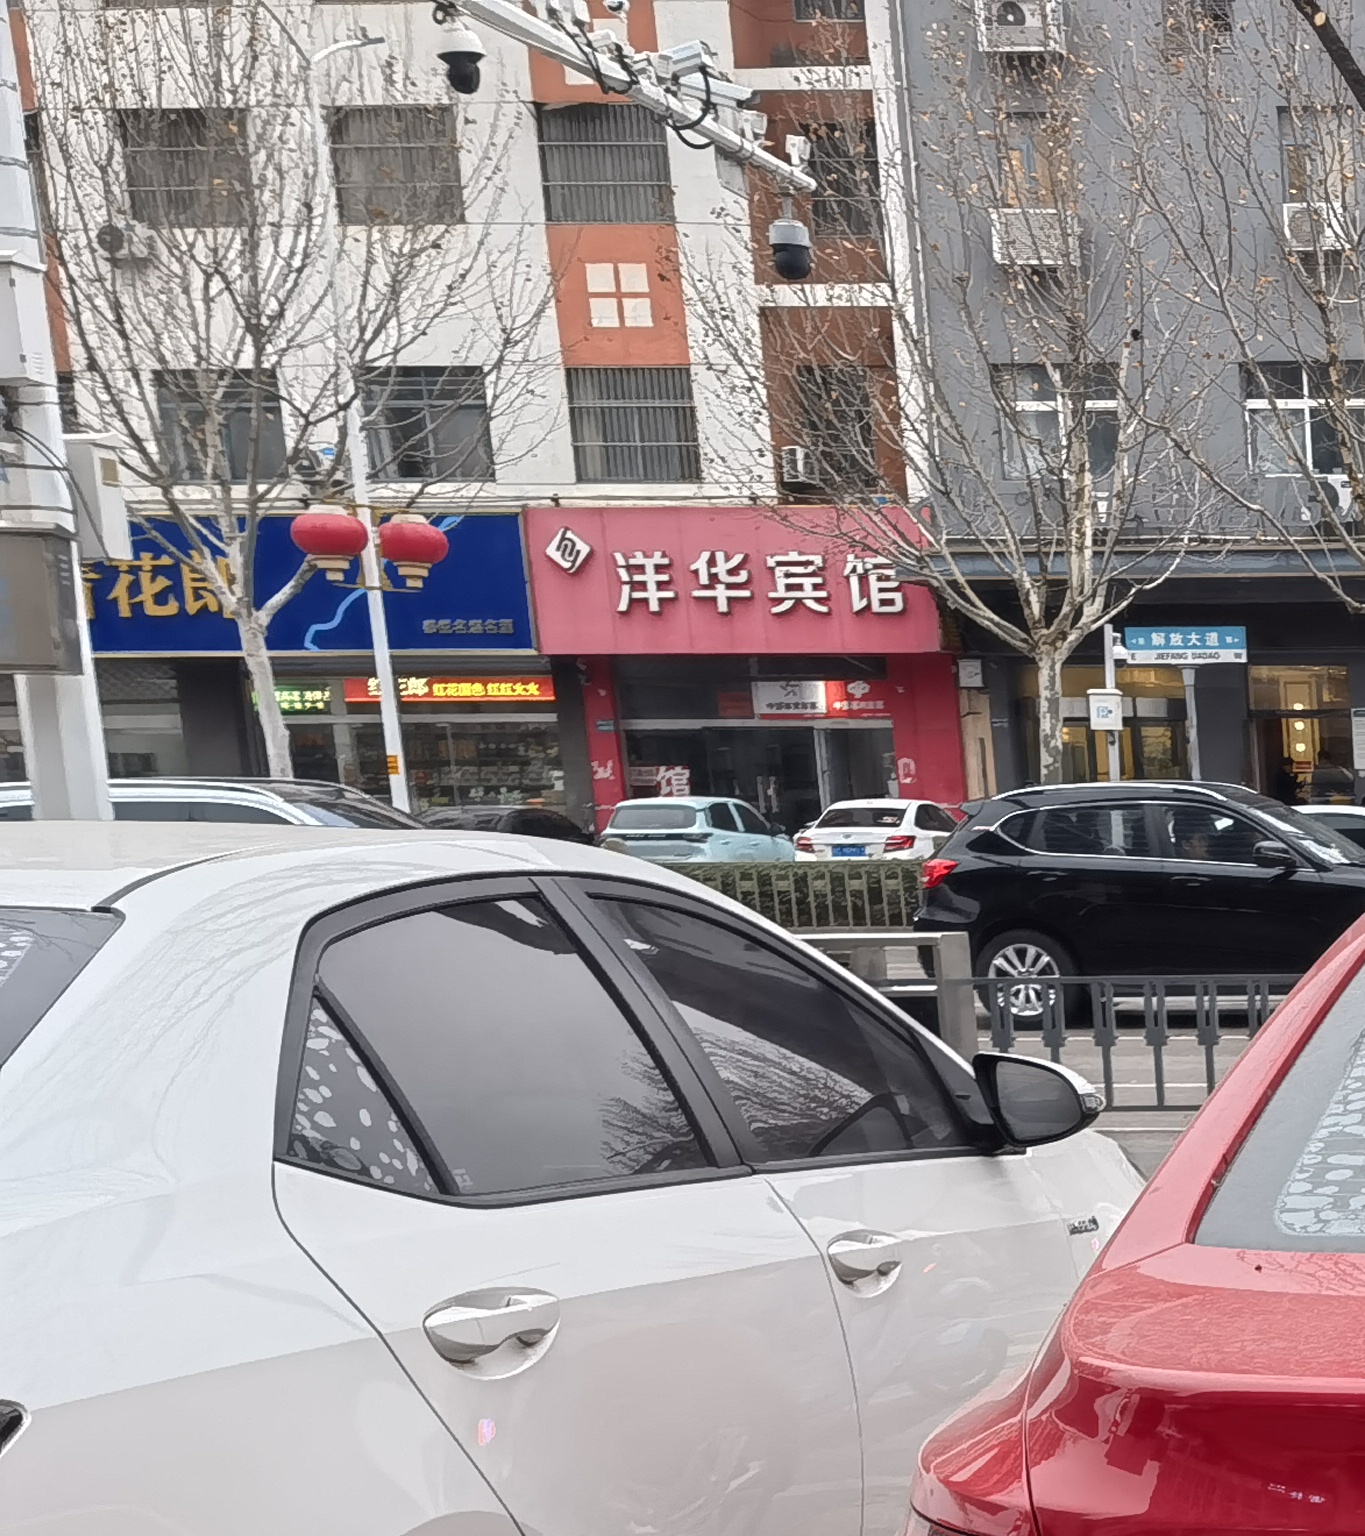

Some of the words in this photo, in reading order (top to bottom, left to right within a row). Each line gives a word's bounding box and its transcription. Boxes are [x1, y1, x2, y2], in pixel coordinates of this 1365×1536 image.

[611, 550, 906, 615] 洋华宾馆
[1150, 631, 1220, 647] 解放大道
